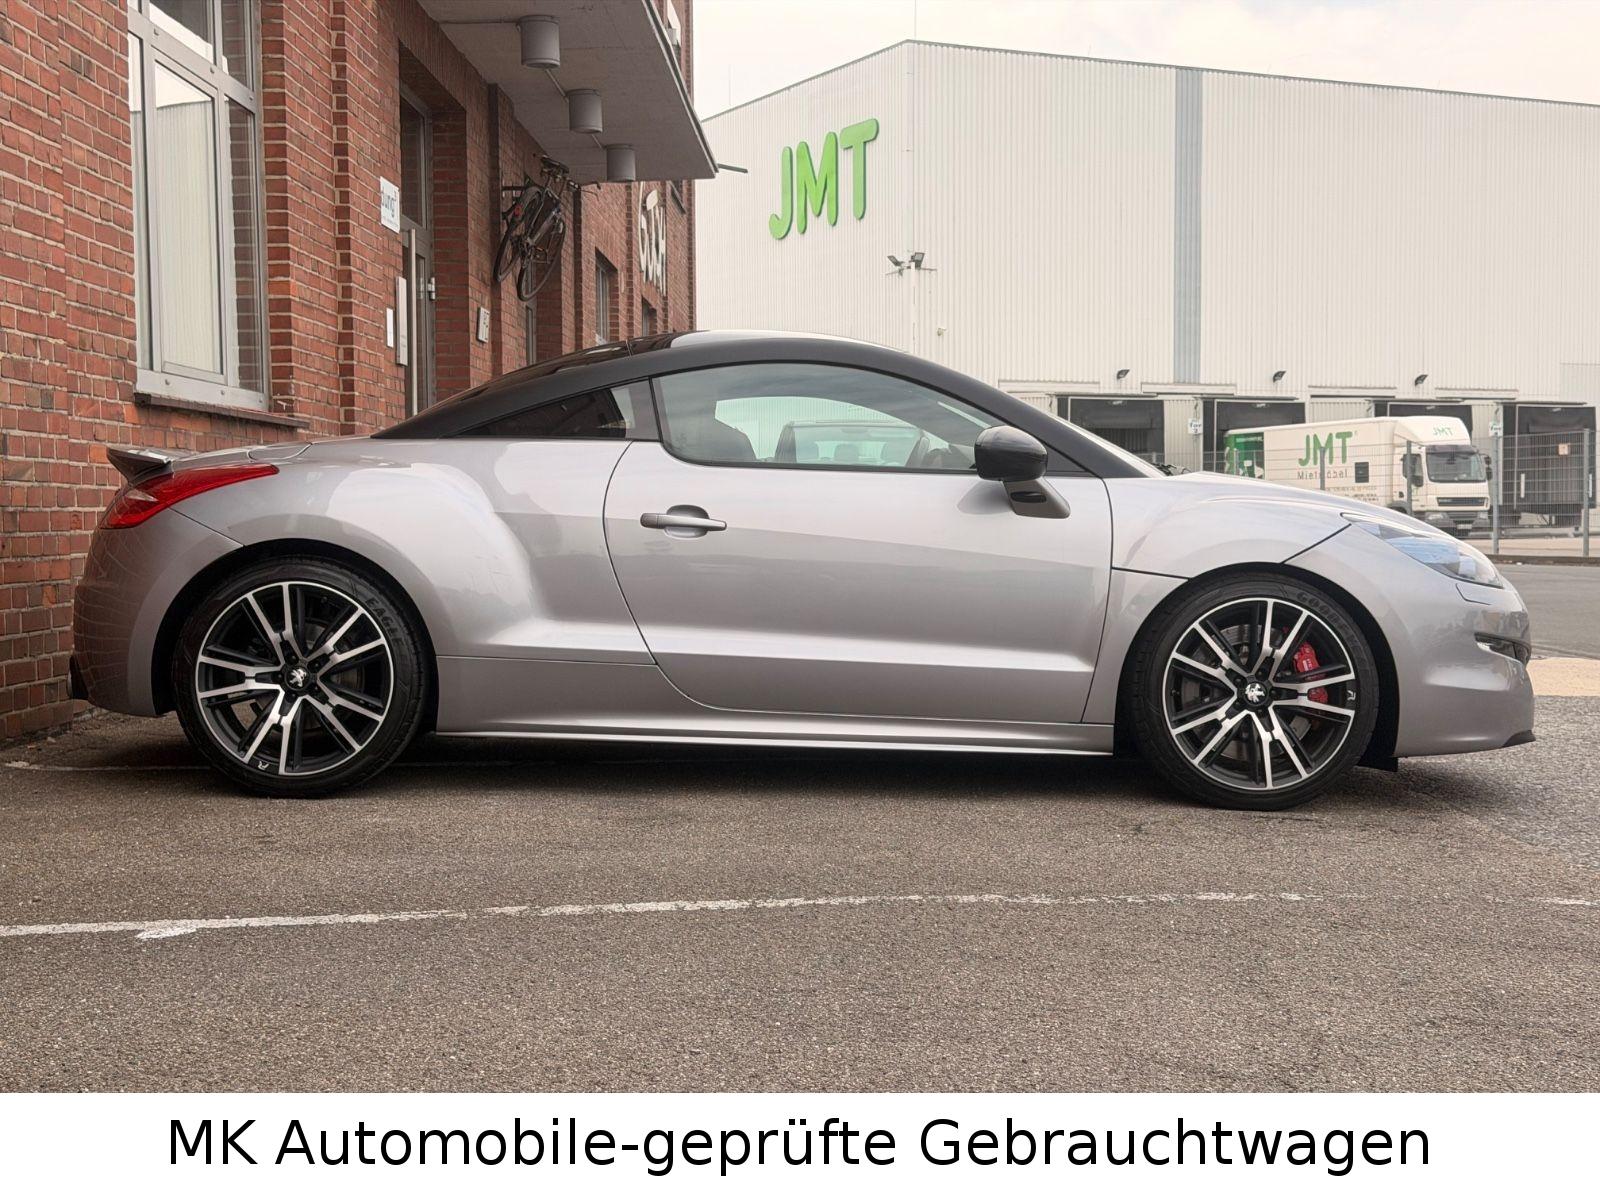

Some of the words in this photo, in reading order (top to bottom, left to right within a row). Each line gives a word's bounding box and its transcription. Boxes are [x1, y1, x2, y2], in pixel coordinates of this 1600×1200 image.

[768, 118, 879, 240] JMT
[1298, 431, 1353, 467] JMT
[1297, 469, 1348, 480] Mietöbel
